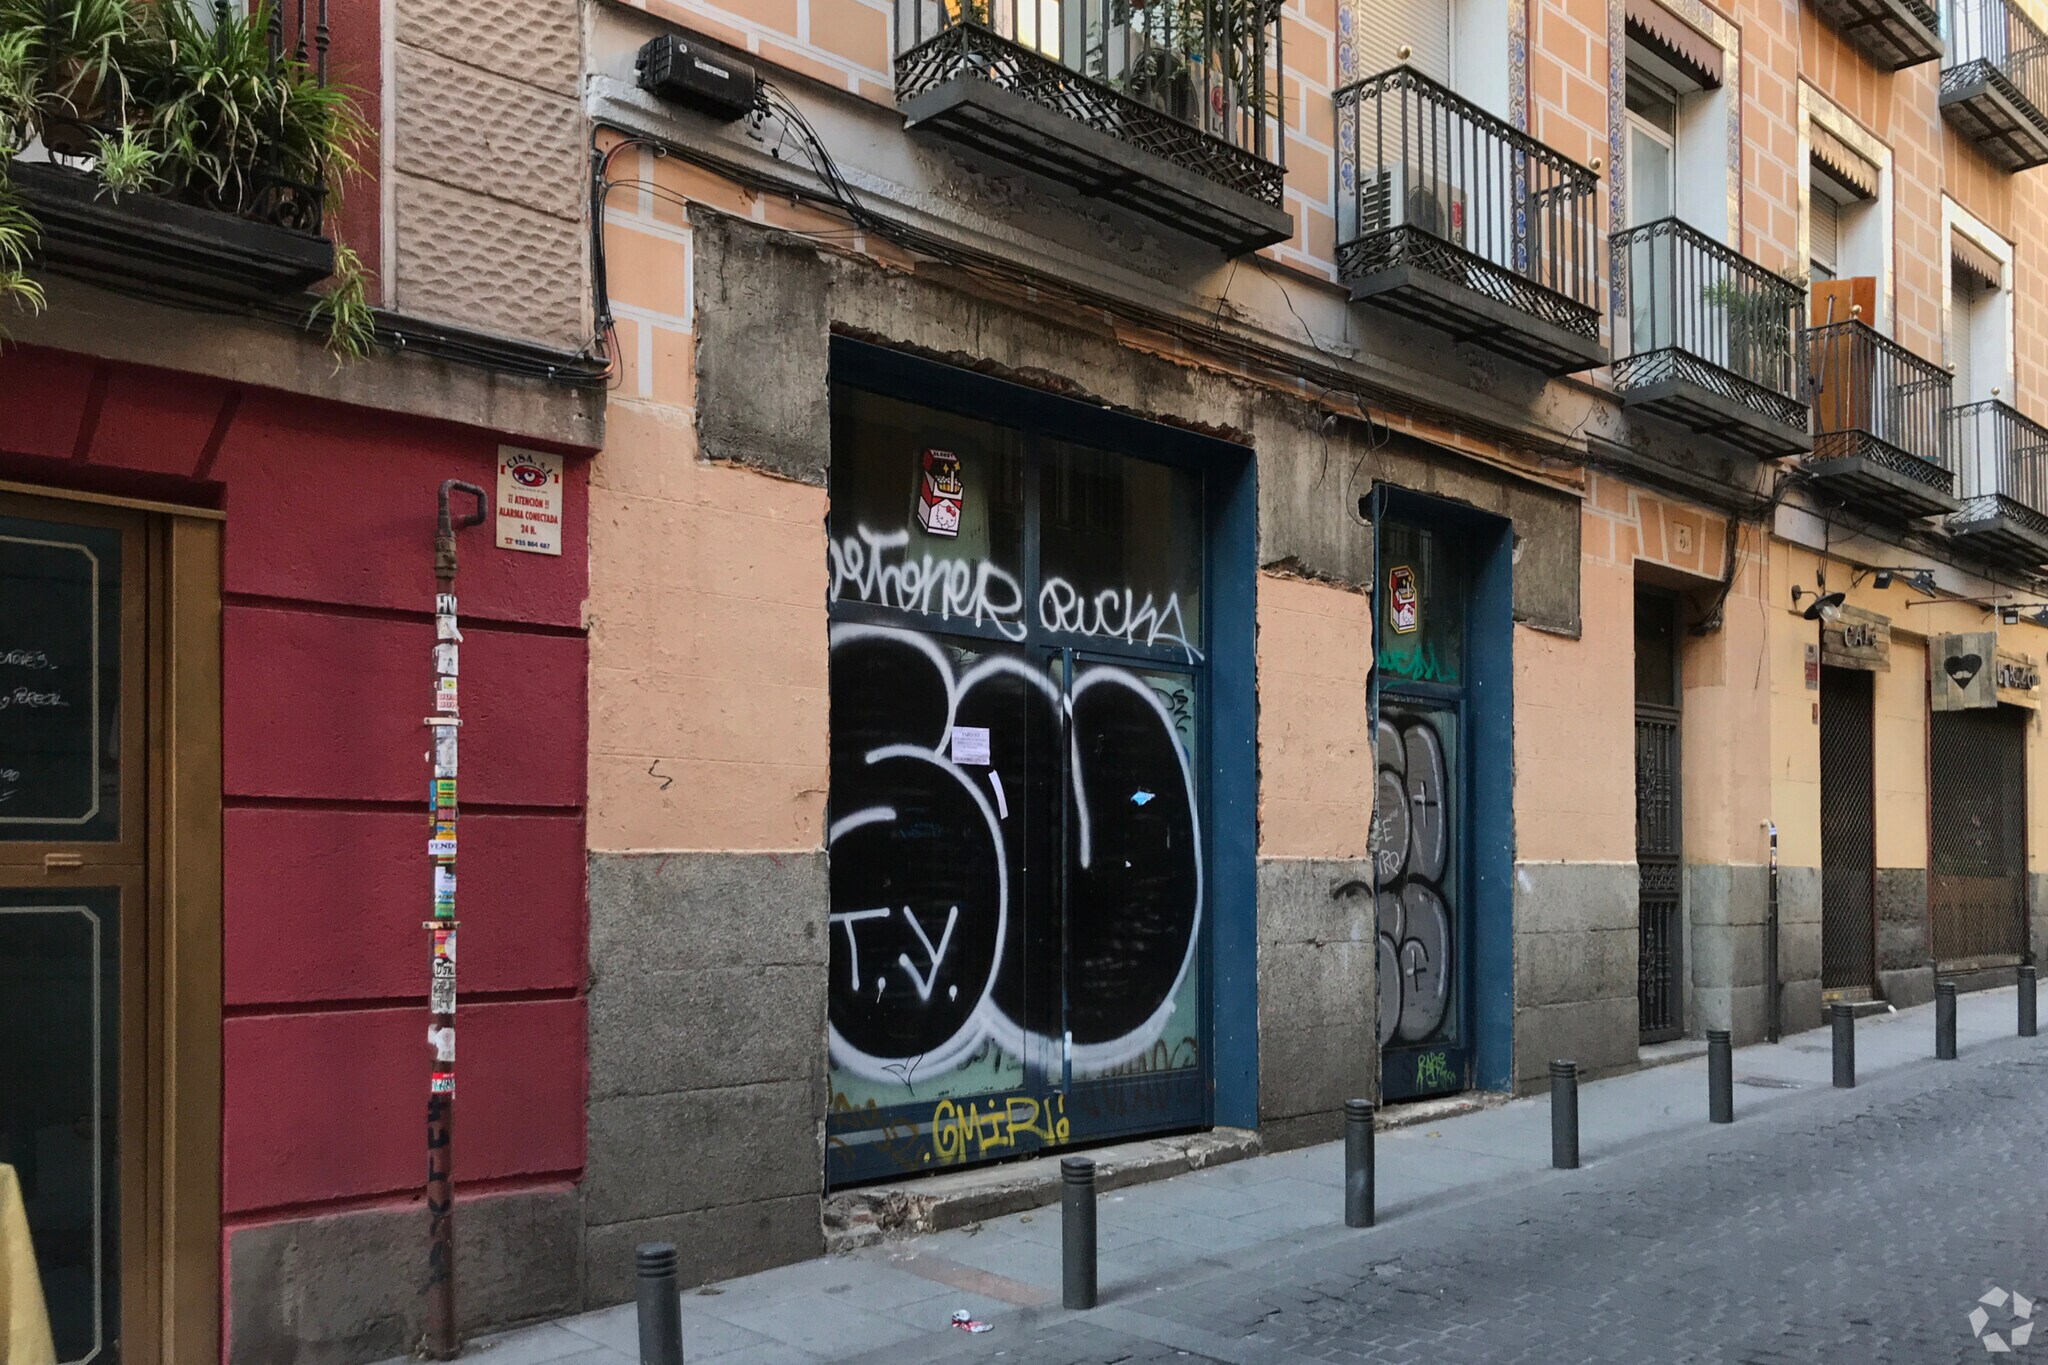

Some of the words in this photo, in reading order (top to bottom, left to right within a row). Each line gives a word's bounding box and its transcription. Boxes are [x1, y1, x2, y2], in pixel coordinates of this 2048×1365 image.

[499, 507, 523, 519] ALARMA
[525, 511, 558, 524] CONECTADA
[520, 524, 529, 534] 24
